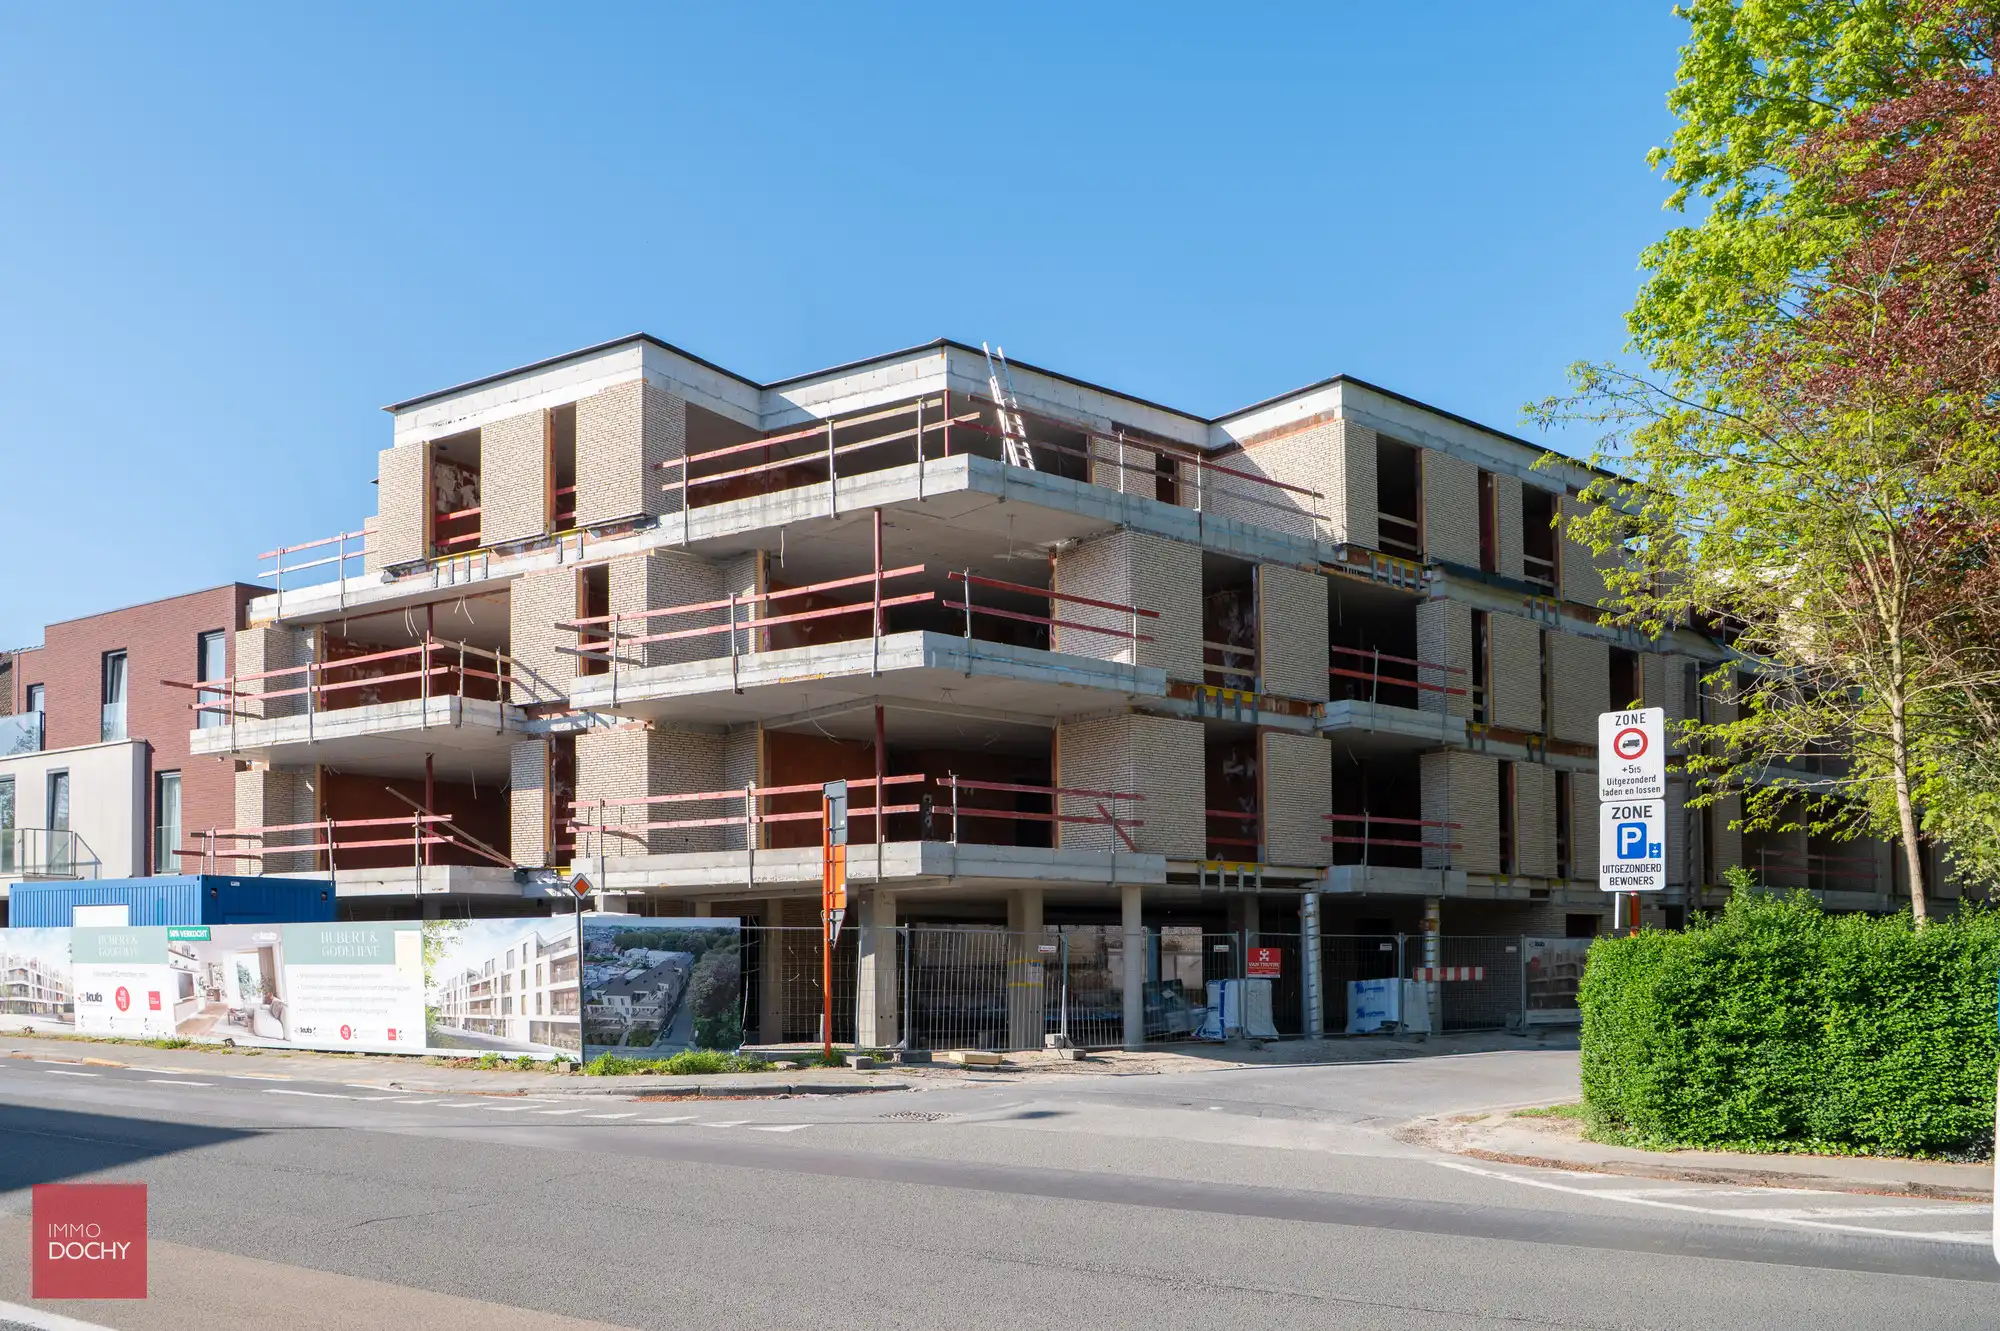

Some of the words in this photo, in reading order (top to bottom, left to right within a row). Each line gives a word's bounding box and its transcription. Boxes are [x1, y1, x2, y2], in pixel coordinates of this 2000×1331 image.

[1615, 713, 1646, 726] ZONE
[1607, 775, 1656, 787] Uitgezonderd
[1602, 788, 1622, 796] laden
[1636, 786, 1660, 794] lossen
[1611, 805, 1652, 819] ZONE
[1621, 827, 1642, 855] P
[1602, 864, 1661, 873] UITGEZONDERD
[1609, 876, 1654, 885] BEWONERS
[181, 930, 207, 938] VERKOCHT
[322, 931, 365, 943] HUBERT
[371, 931, 378, 942] &
[86, 992, 102, 1002] kub
